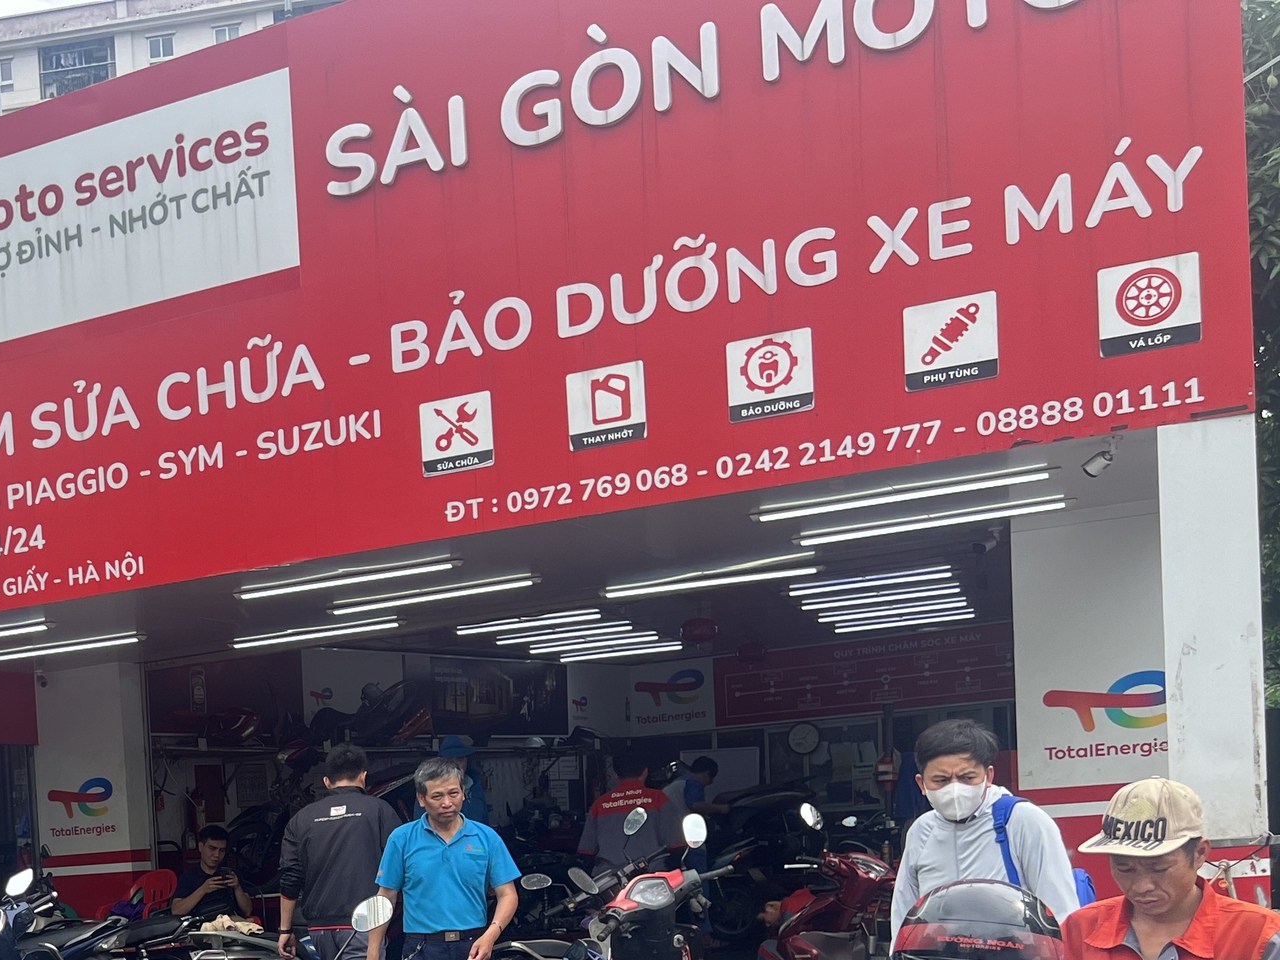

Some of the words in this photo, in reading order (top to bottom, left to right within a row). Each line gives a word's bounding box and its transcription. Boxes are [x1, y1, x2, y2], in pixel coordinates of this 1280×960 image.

[324, 86, 467, 197] SÀI
[500, 24, 721, 148] GÒN
[760, 0, 1080, 82] MO
[75, 120, 269, 207] services
[15, 223, 83, 265] ĐỈNH
[108, 186, 188, 241] NHỚT
[190, 165, 270, 216] CHẤT
[30, 379, 141, 448] SỬA
[156, 334, 324, 419] CHỮA
[389, 289, 533, 377] BẢO
[554, 233, 839, 340] DƯỠNG
[868, 196, 974, 274] XE
[1004, 136, 1204, 246] MÁY
[1129, 336, 1145, 349] VÁ
[1147, 332, 1172, 347] LỐP
[923, 372, 946, 385] PHỤ
[948, 366, 979, 380] TÙNG
[444, 498, 484, 522] ĐT
[506, 482, 573, 513] 0972
[579, 472, 631, 502] 769
[635, 463, 688, 492] 068
[715, 446, 791, 480] 0242
[797, 432, 876, 468] 2149
[882, 419, 942, 453] 777
[976, 396, 1084, 437] 08888
[1092, 376, 1205, 417] 01111
[582, 435, 607, 446] THAY
[608, 429, 634, 442] NHỚT
[7, 463, 129, 509] PIAGGIO
[159, 442, 222, 481] SYM
[256, 409, 382, 462] SUZUKI
[436, 459, 455, 471] SỬA
[456, 456, 480, 469] CHỮA
[1, 566, 50, 599] GIẤY
[68, 562, 100, 588] HÀ
[105, 554, 145, 584] NỘI
[635, 708, 707, 726] TotalEnergies
[602, 797, 652, 808] TotalEnergies
[50, 822, 116, 839] TotalEnergies
[1103, 815, 1167, 842] MEXICO
